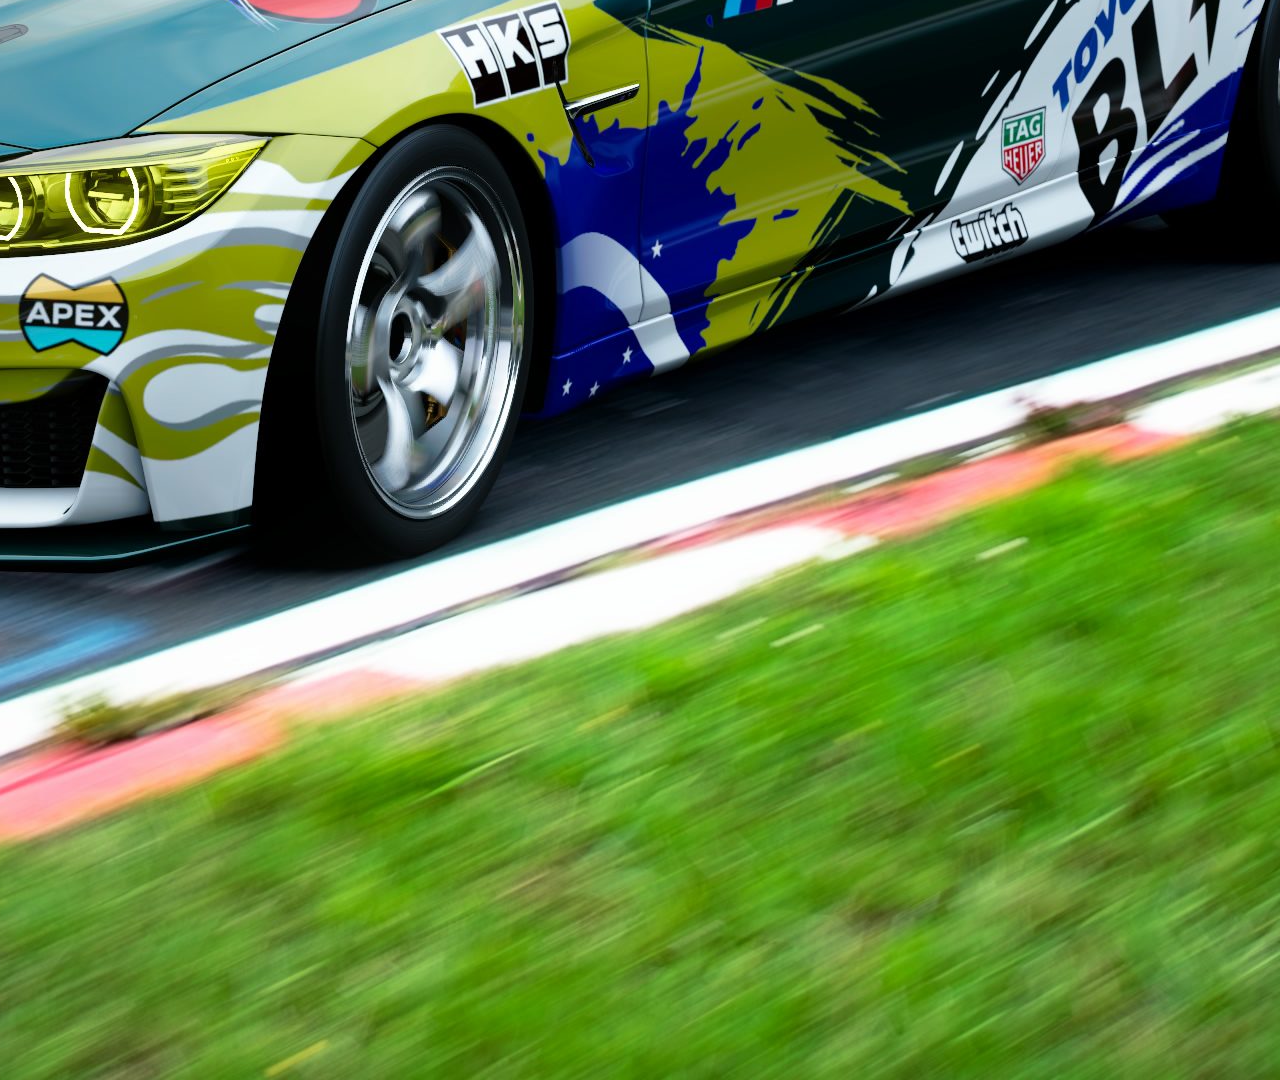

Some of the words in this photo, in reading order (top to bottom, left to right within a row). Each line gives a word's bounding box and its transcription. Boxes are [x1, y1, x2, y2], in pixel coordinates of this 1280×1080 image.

[446, 6, 568, 80] HKS
[1006, 115, 1041, 143] TAG
[1004, 141, 1043, 176] HEUER
[950, 203, 1029, 260] twitch
[24, 300, 122, 329] APEX
